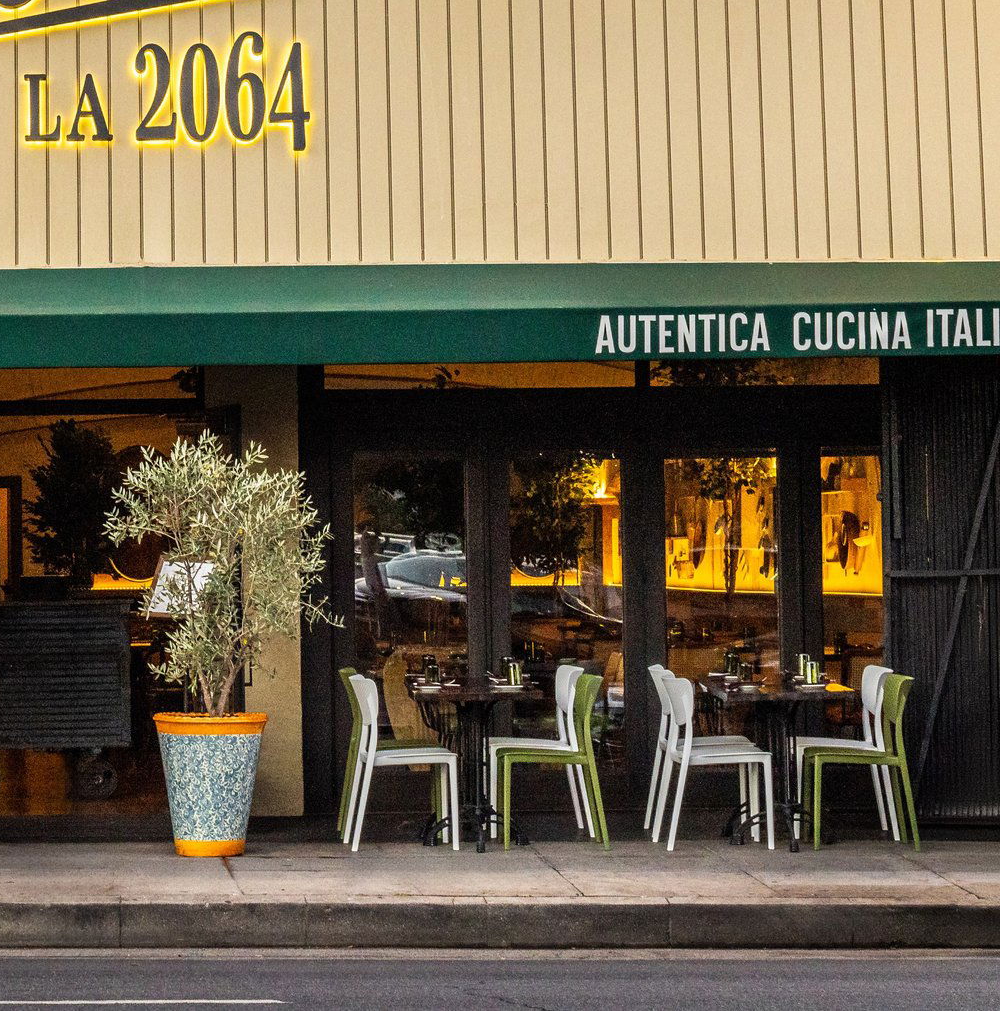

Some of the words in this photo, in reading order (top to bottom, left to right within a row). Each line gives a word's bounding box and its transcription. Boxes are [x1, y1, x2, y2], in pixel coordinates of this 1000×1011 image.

[23, 73, 113, 142] LA
[134, 31, 310, 151] 2064
[595, 313, 770, 353] AUTENTICA
[792, 310, 912, 350] CUCINA
[926, 308, 1000, 347] ITALI
